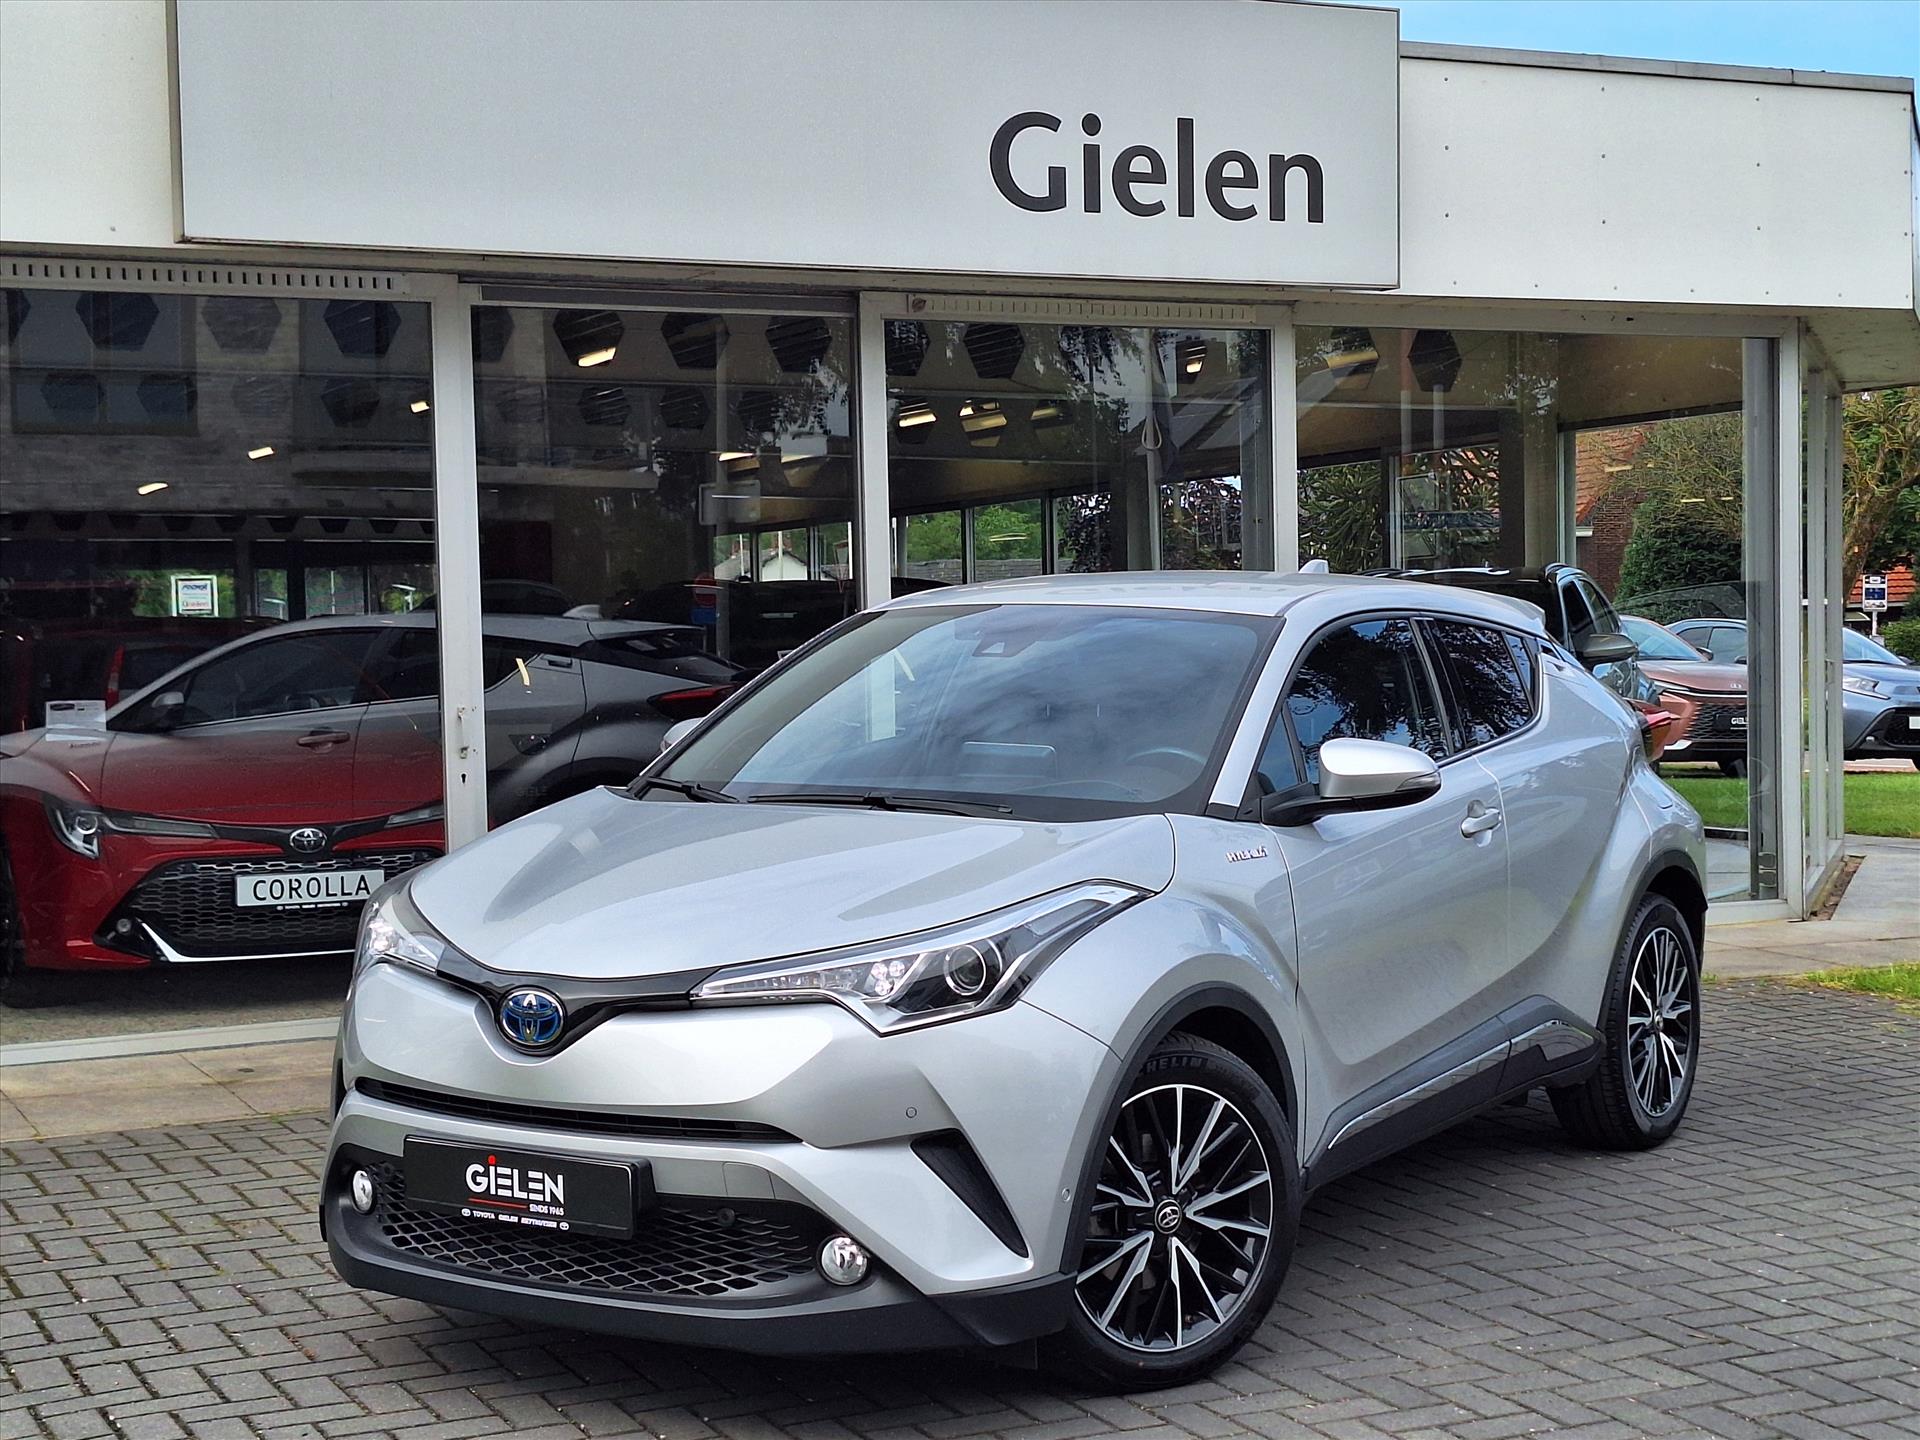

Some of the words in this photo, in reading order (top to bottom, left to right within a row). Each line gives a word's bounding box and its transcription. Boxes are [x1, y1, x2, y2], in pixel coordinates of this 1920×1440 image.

[989, 111, 1324, 223] Gielen
[252, 874, 371, 901] COROLLA
[472, 1210, 496, 1219] TOYOTA
